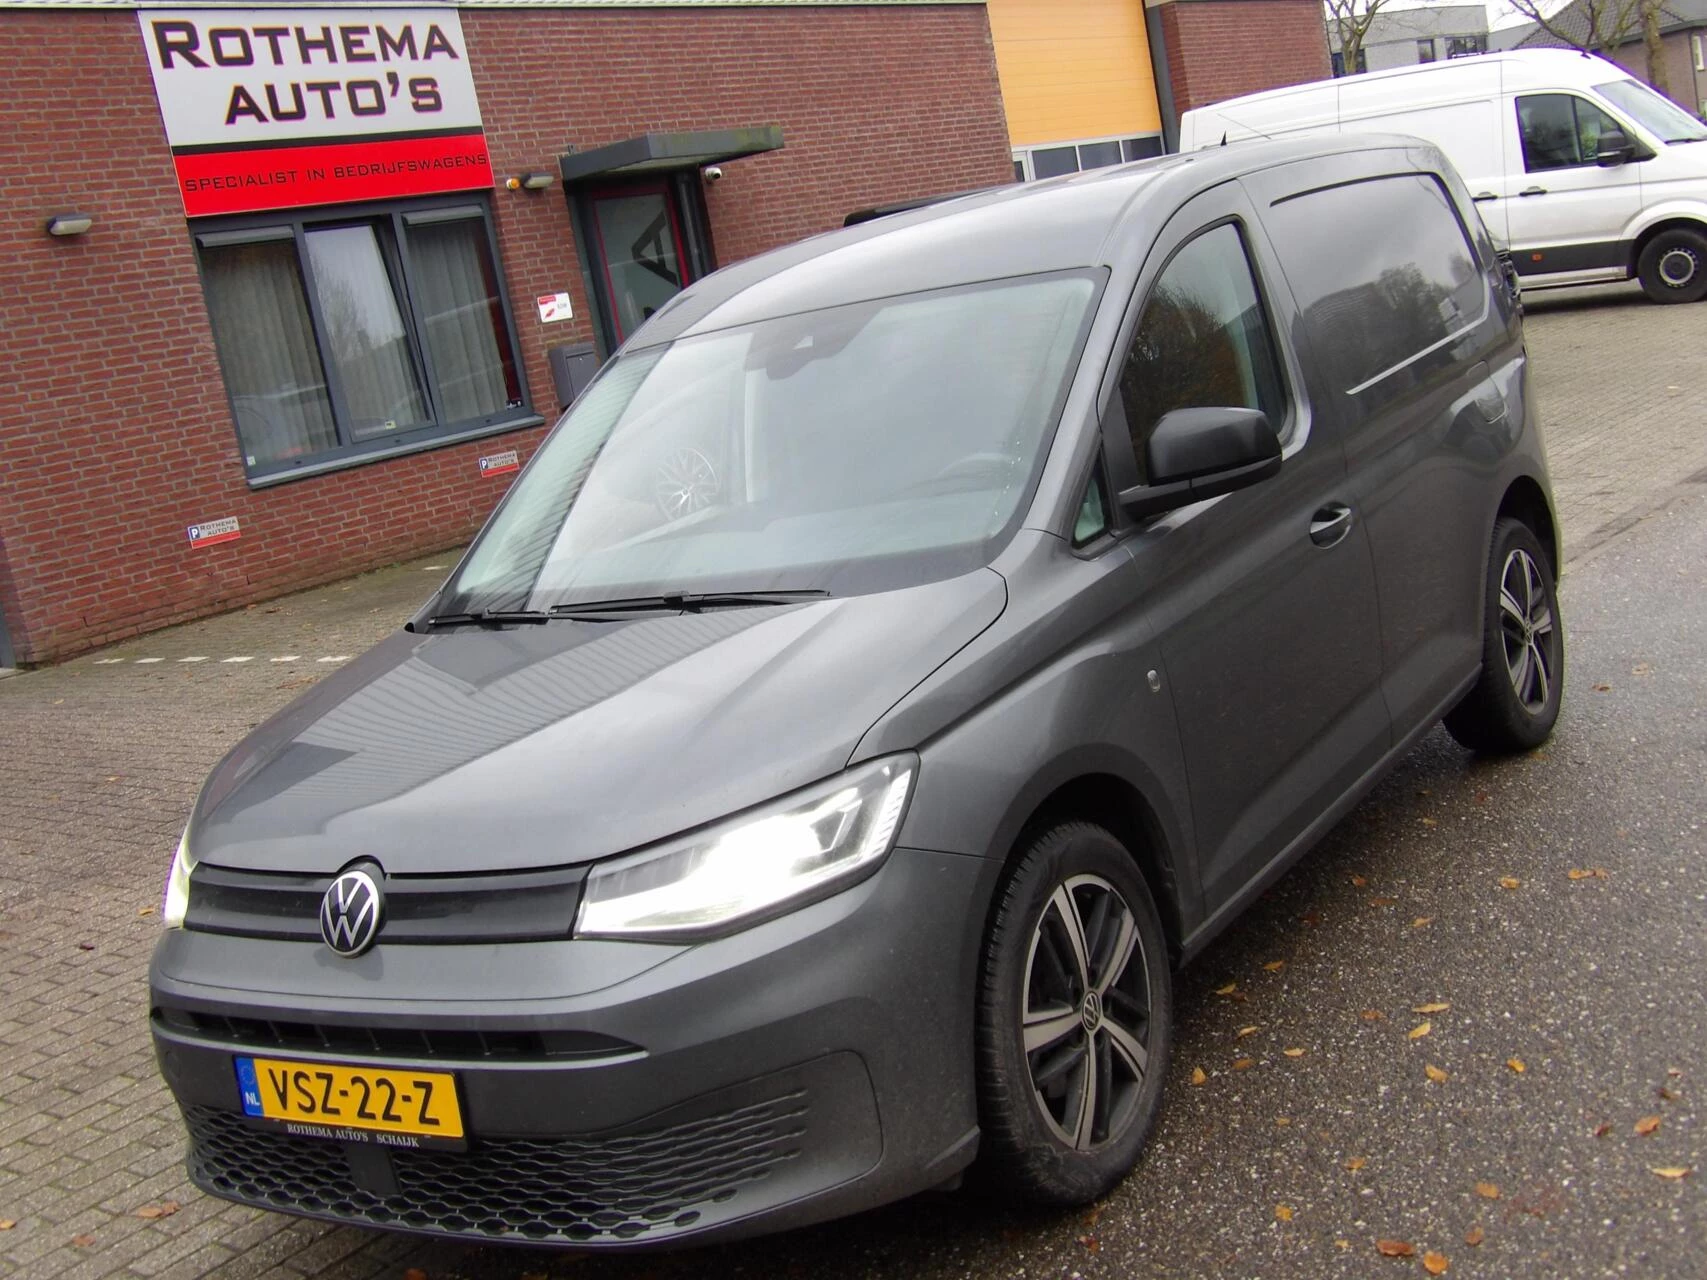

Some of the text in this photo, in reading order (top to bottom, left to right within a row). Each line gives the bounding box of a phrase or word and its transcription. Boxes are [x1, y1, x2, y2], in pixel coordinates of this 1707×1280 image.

[151, 20, 460, 70] ROTHEMA
[225, 71, 444, 126] AUTO'S
[184, 153, 488, 193] SPECIALIST IN BEDRIJFSWAGENS
[199, 519, 237, 531] ROTHEMA
[245, 1067, 441, 1127] NL VSZ-22-Z
[287, 1123, 333, 1139] ROTHEMA
[335, 1127, 369, 1143] AUTO'S
